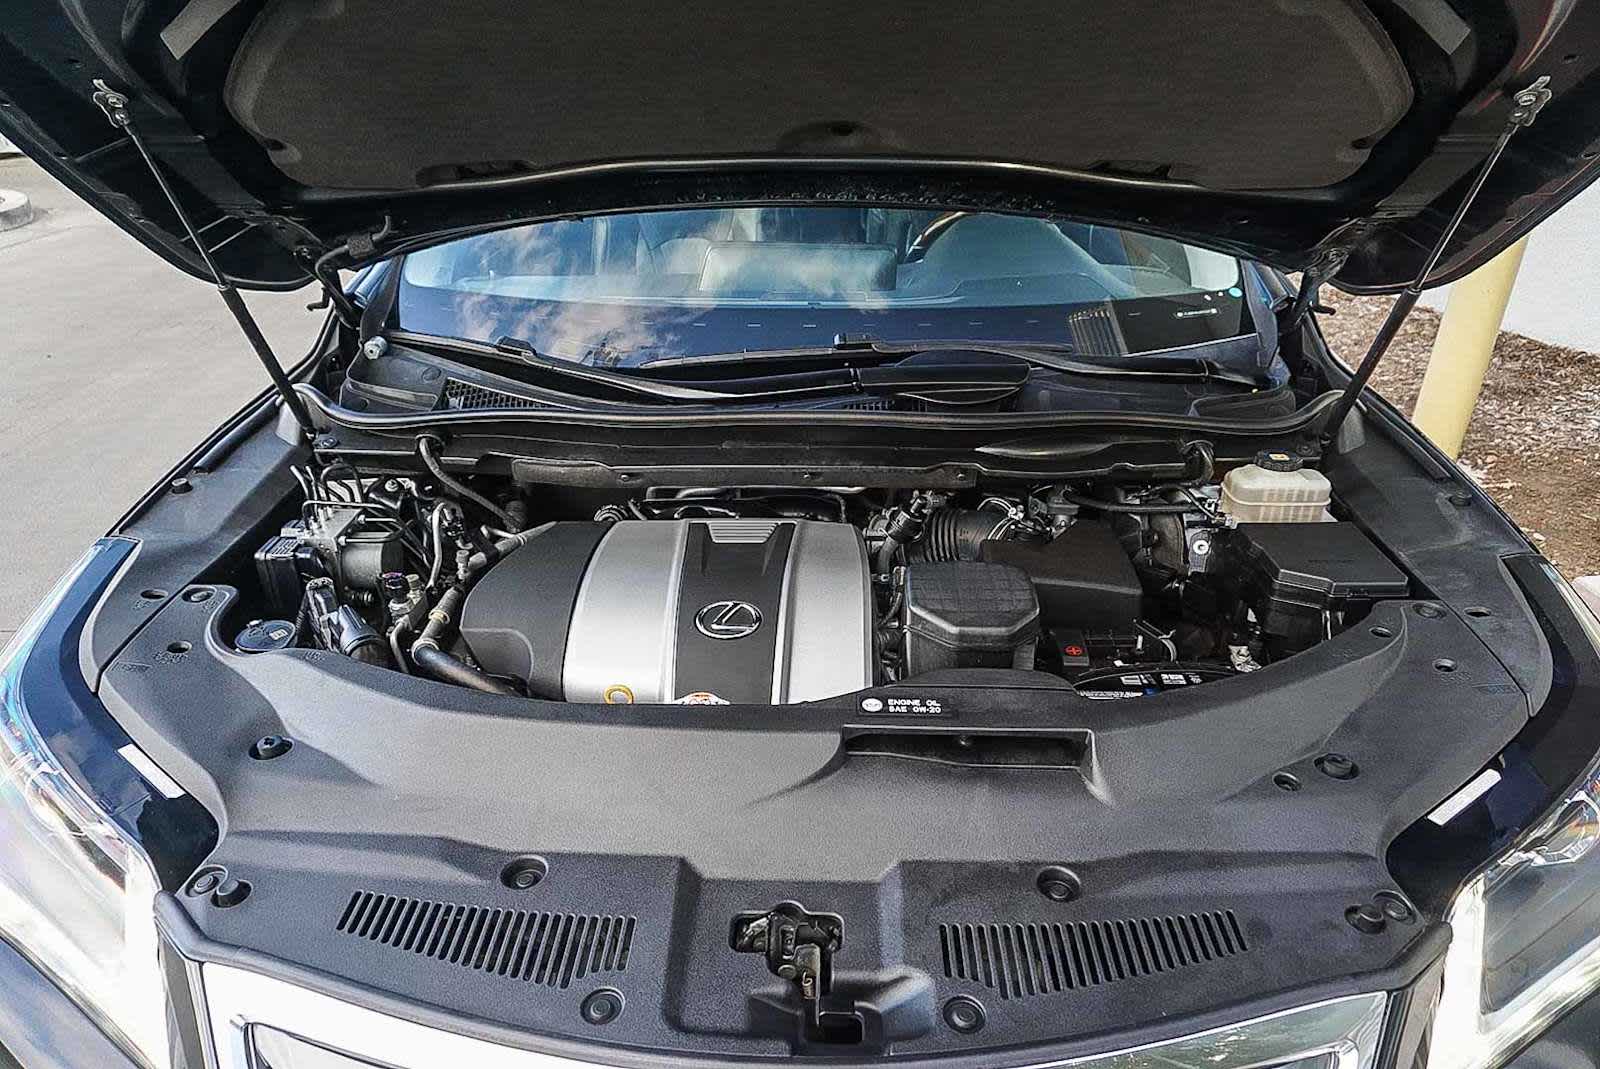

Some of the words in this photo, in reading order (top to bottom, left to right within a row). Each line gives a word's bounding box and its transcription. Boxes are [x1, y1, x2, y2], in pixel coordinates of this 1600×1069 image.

[887, 698, 921, 706] ENGINE
[888, 705, 908, 713] SAE
[912, 706, 942, 714] 0W-20
